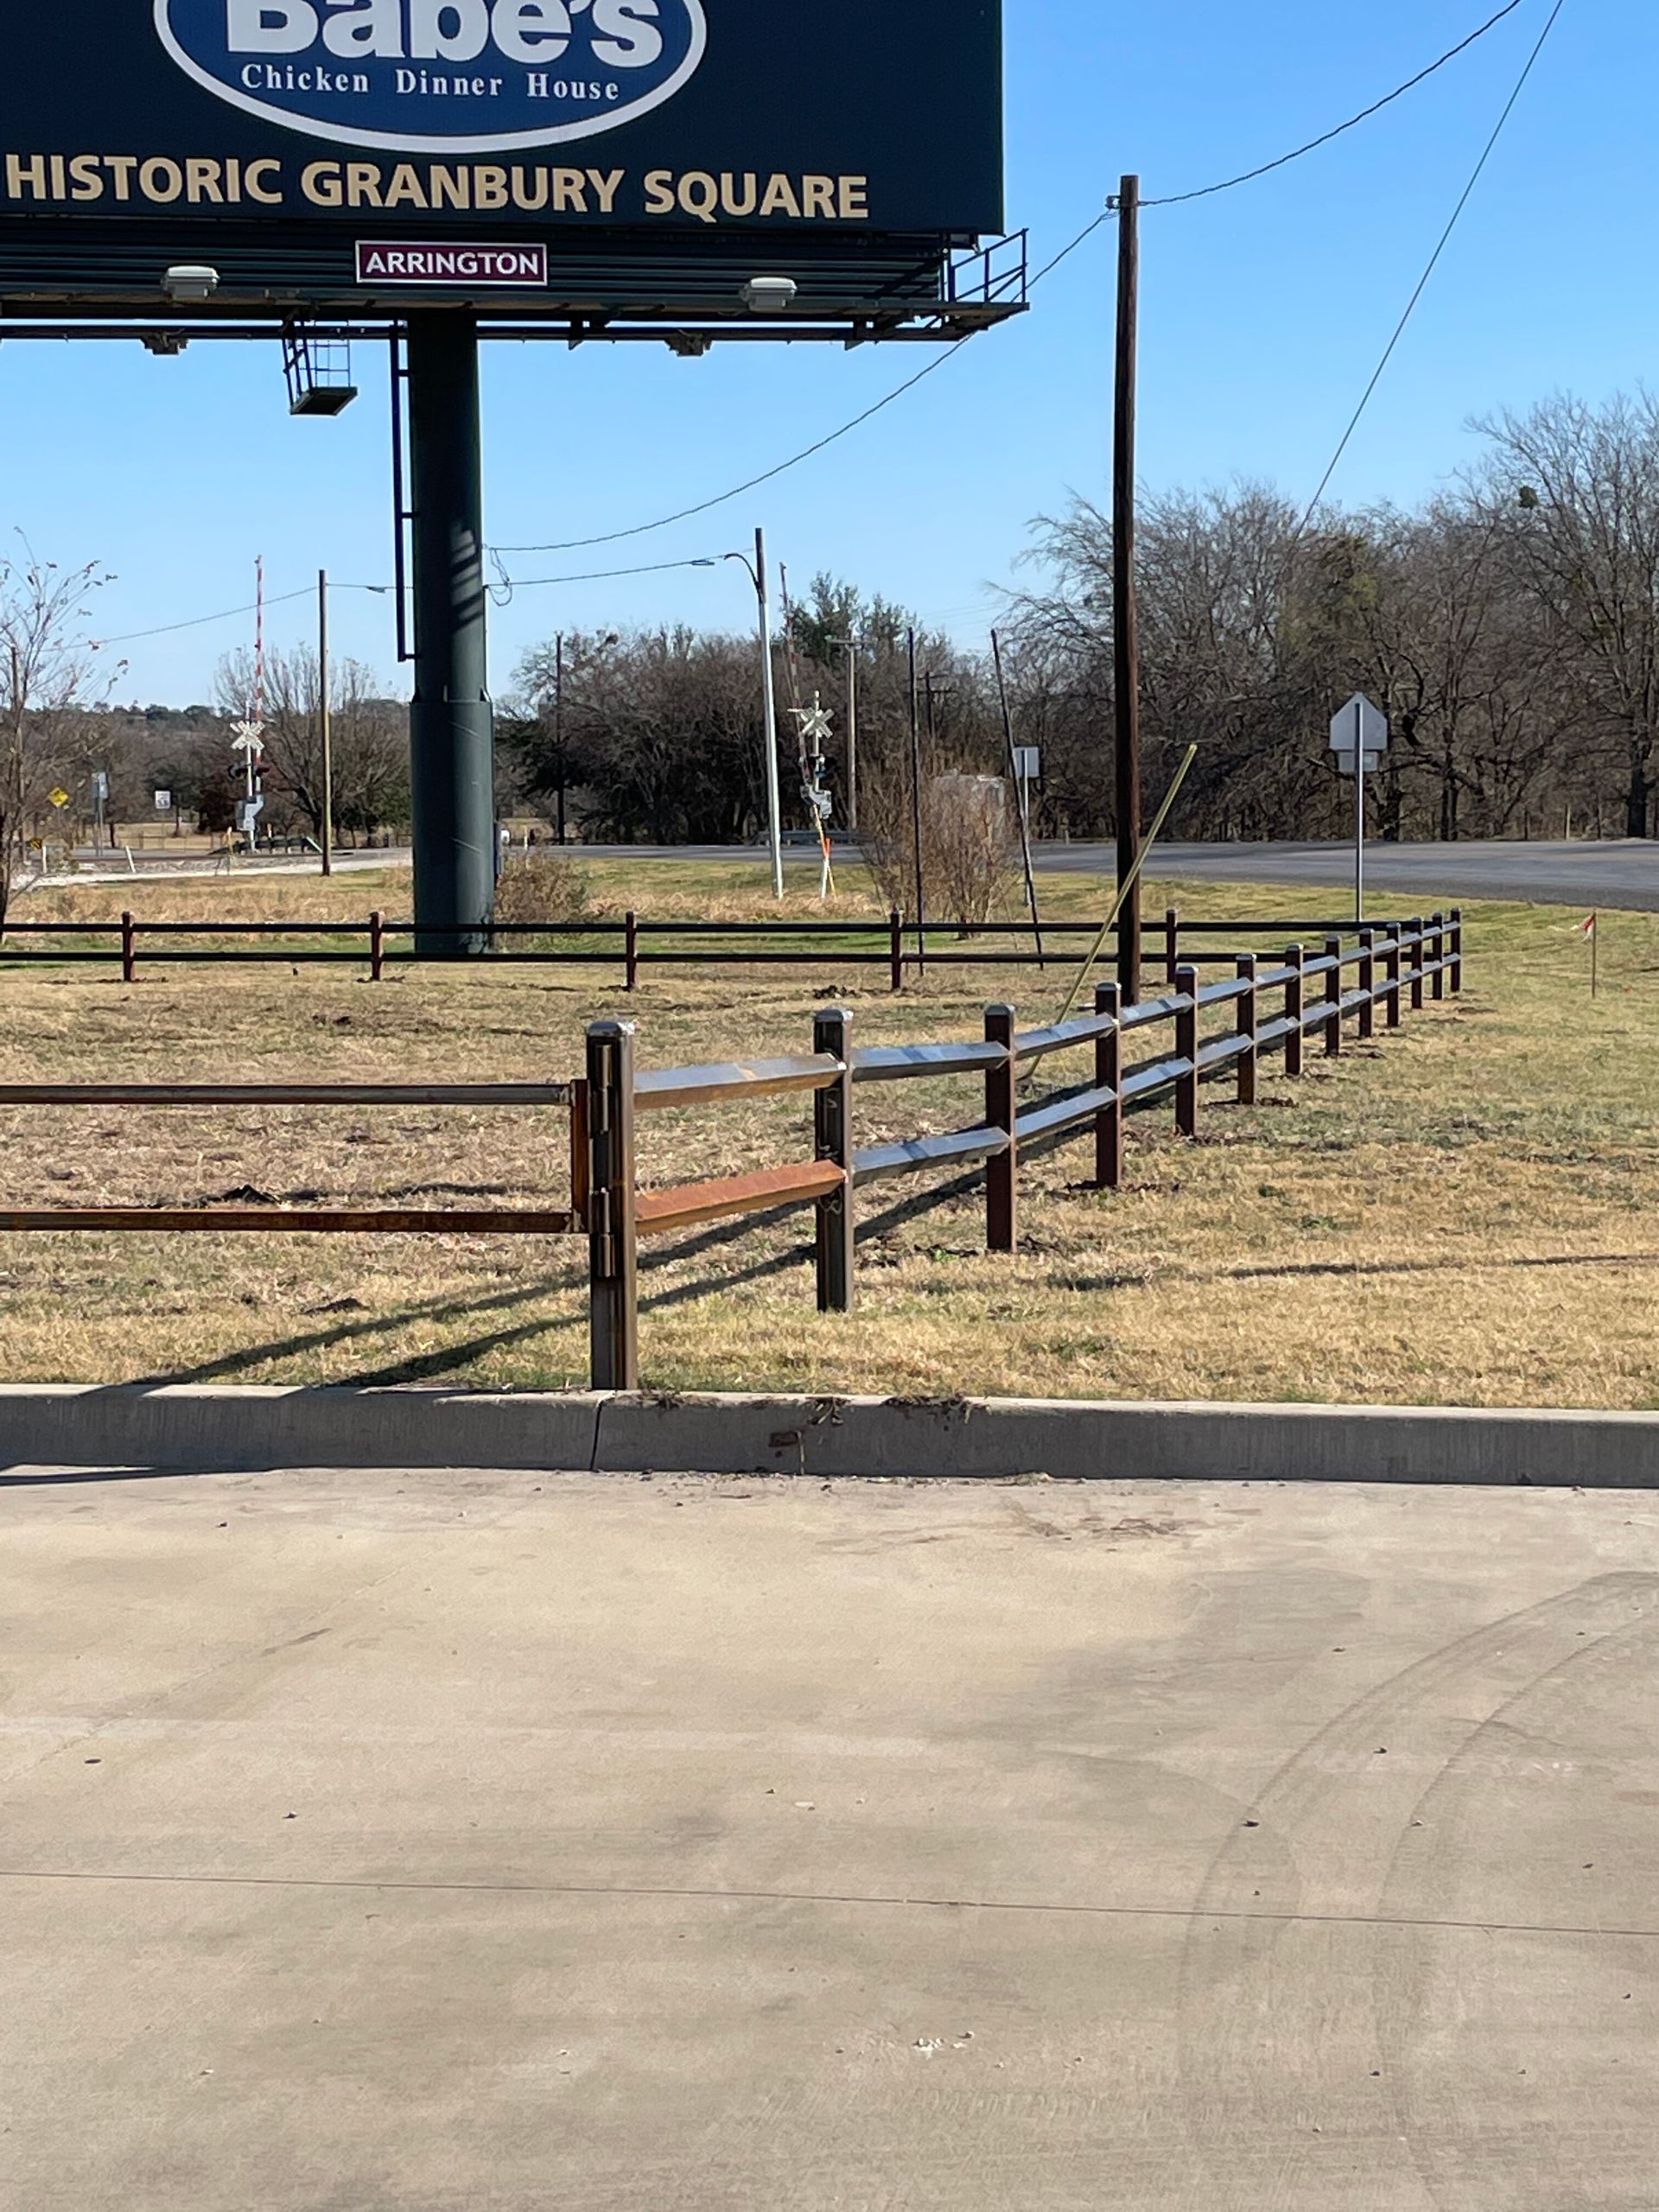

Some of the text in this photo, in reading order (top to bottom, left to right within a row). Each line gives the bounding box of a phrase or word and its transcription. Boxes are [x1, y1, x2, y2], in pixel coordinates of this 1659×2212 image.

[241, 64, 619, 100] Chicken Dinner House
[6, 154, 868, 223] HISTORIC GRANBURY SQUARE
[365, 251, 539, 275] ARRINGTON
